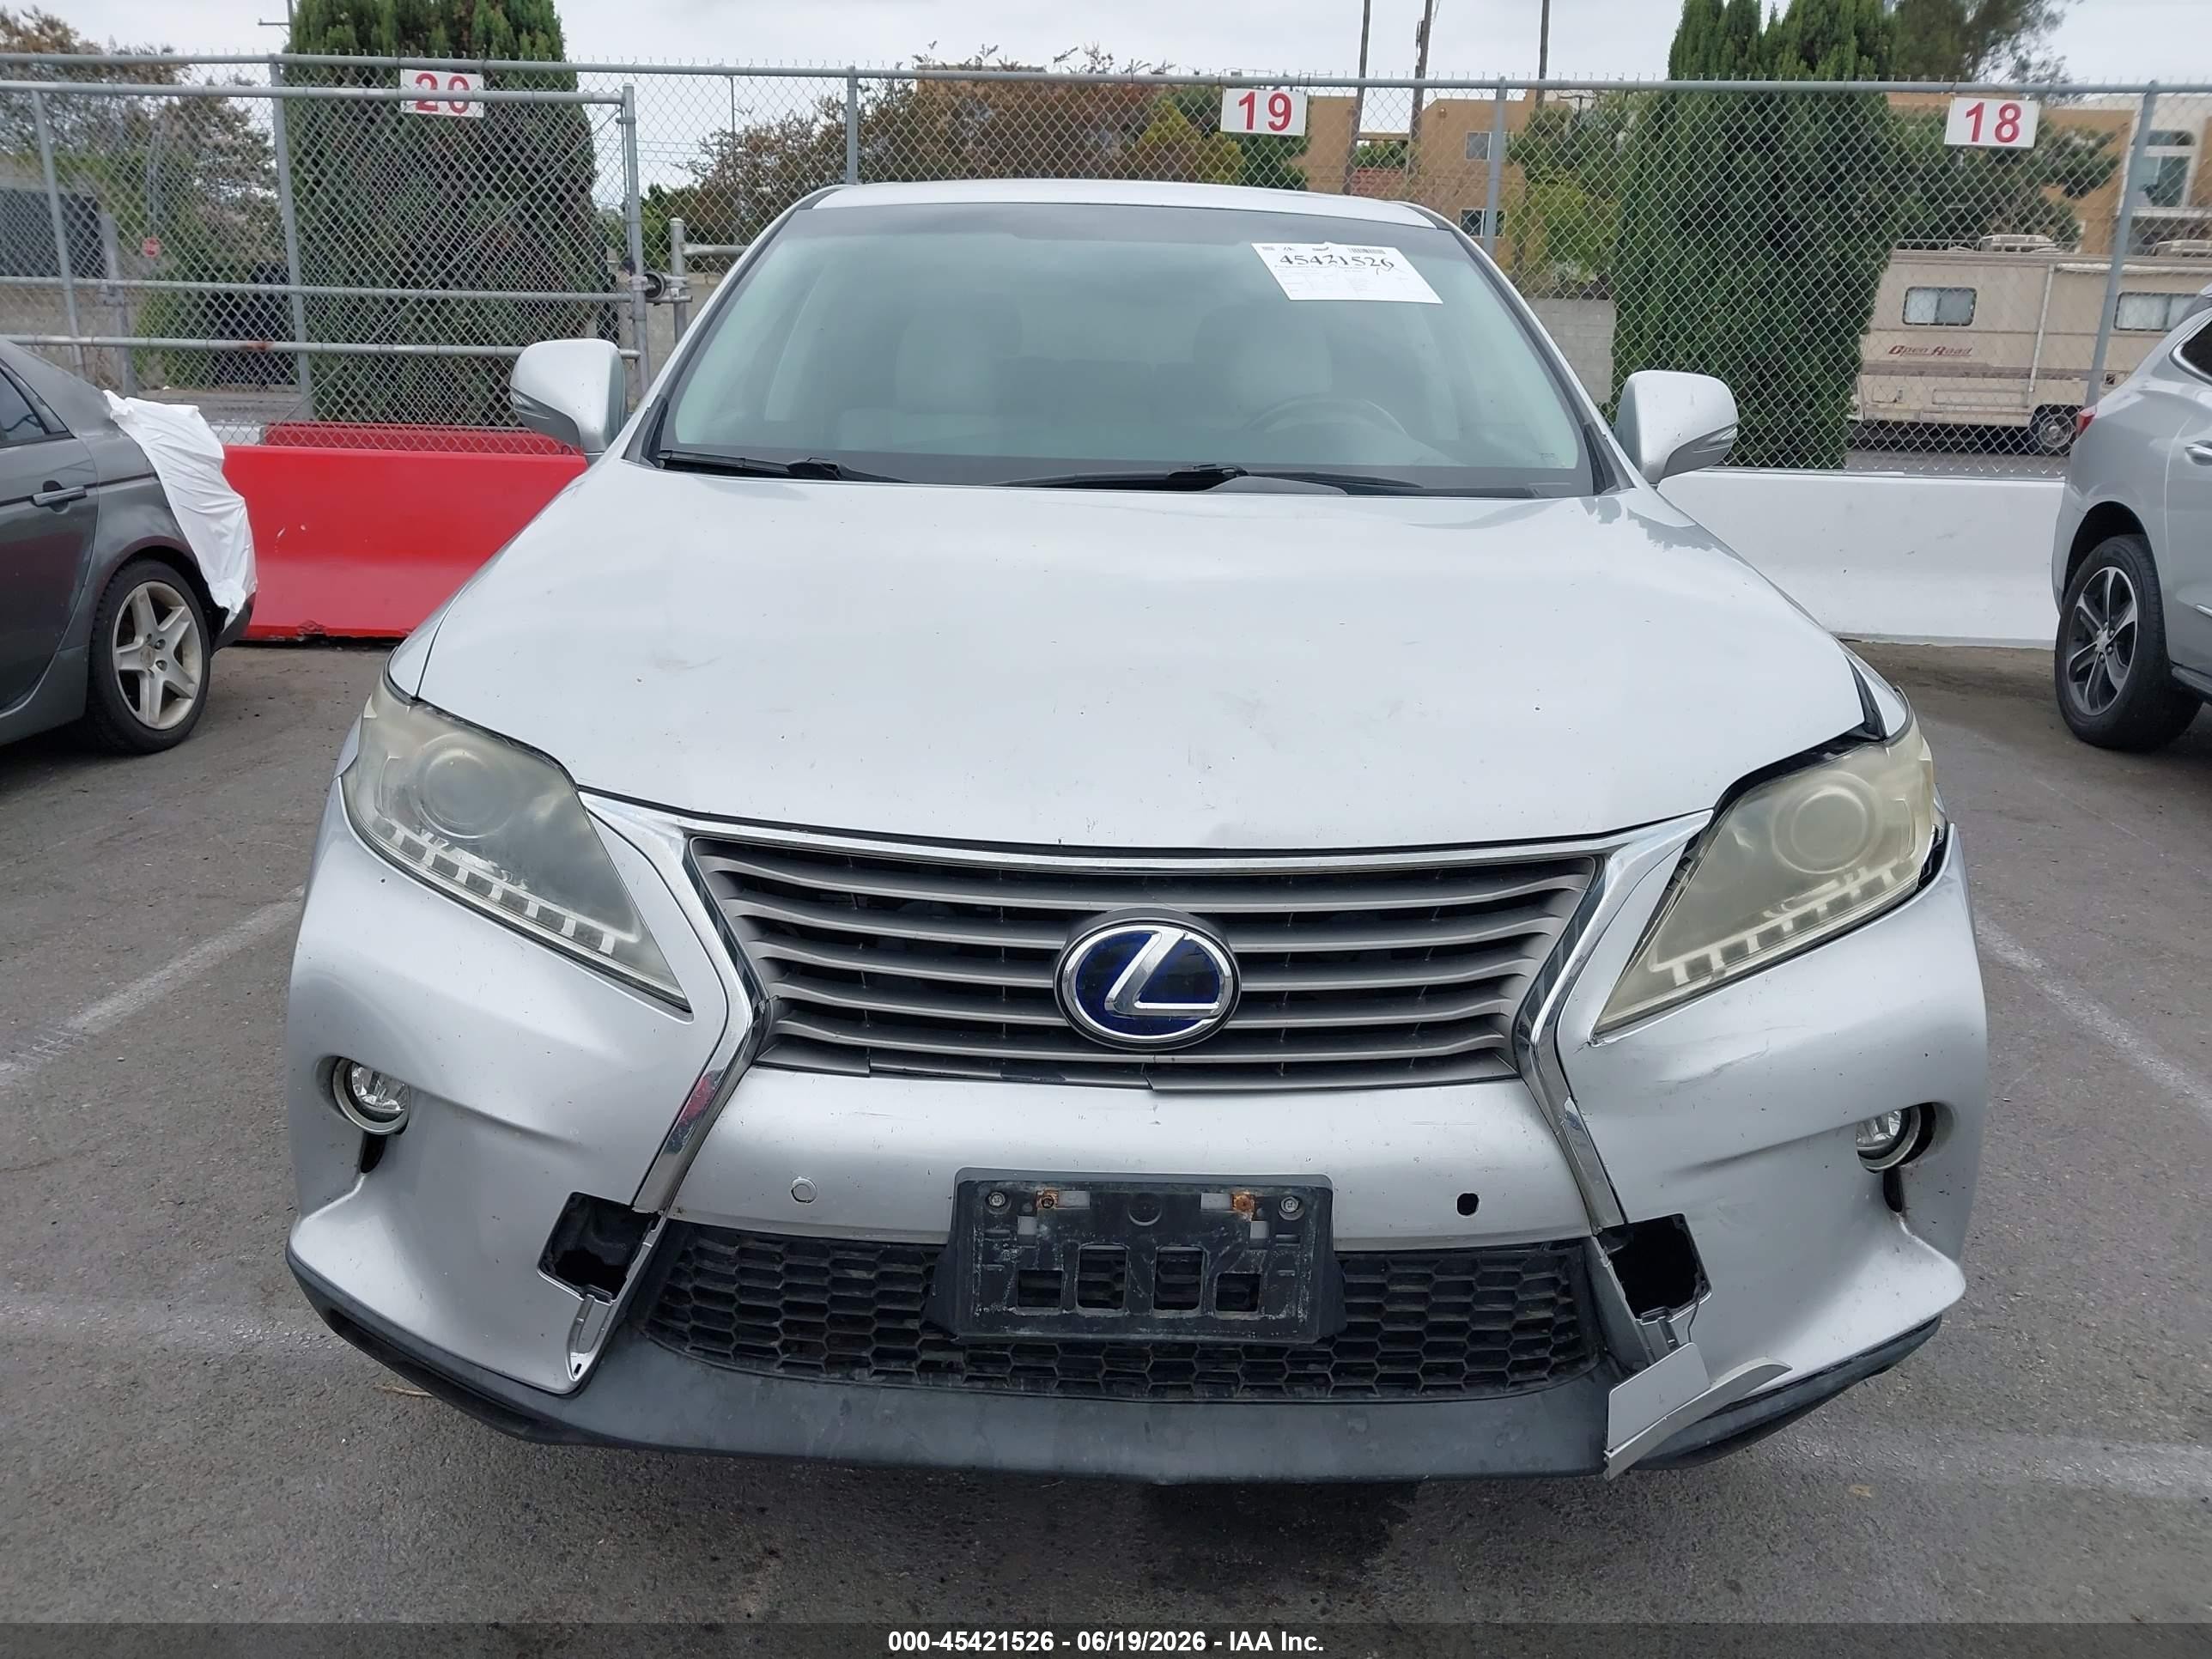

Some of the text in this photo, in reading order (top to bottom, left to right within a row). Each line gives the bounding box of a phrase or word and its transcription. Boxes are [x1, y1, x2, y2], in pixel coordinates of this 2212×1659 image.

[416, 72, 471, 114] 20
[1238, 91, 1292, 131] 19
[1966, 101, 2021, 143] 18
[1888, 345, 1973, 356] Open Road
